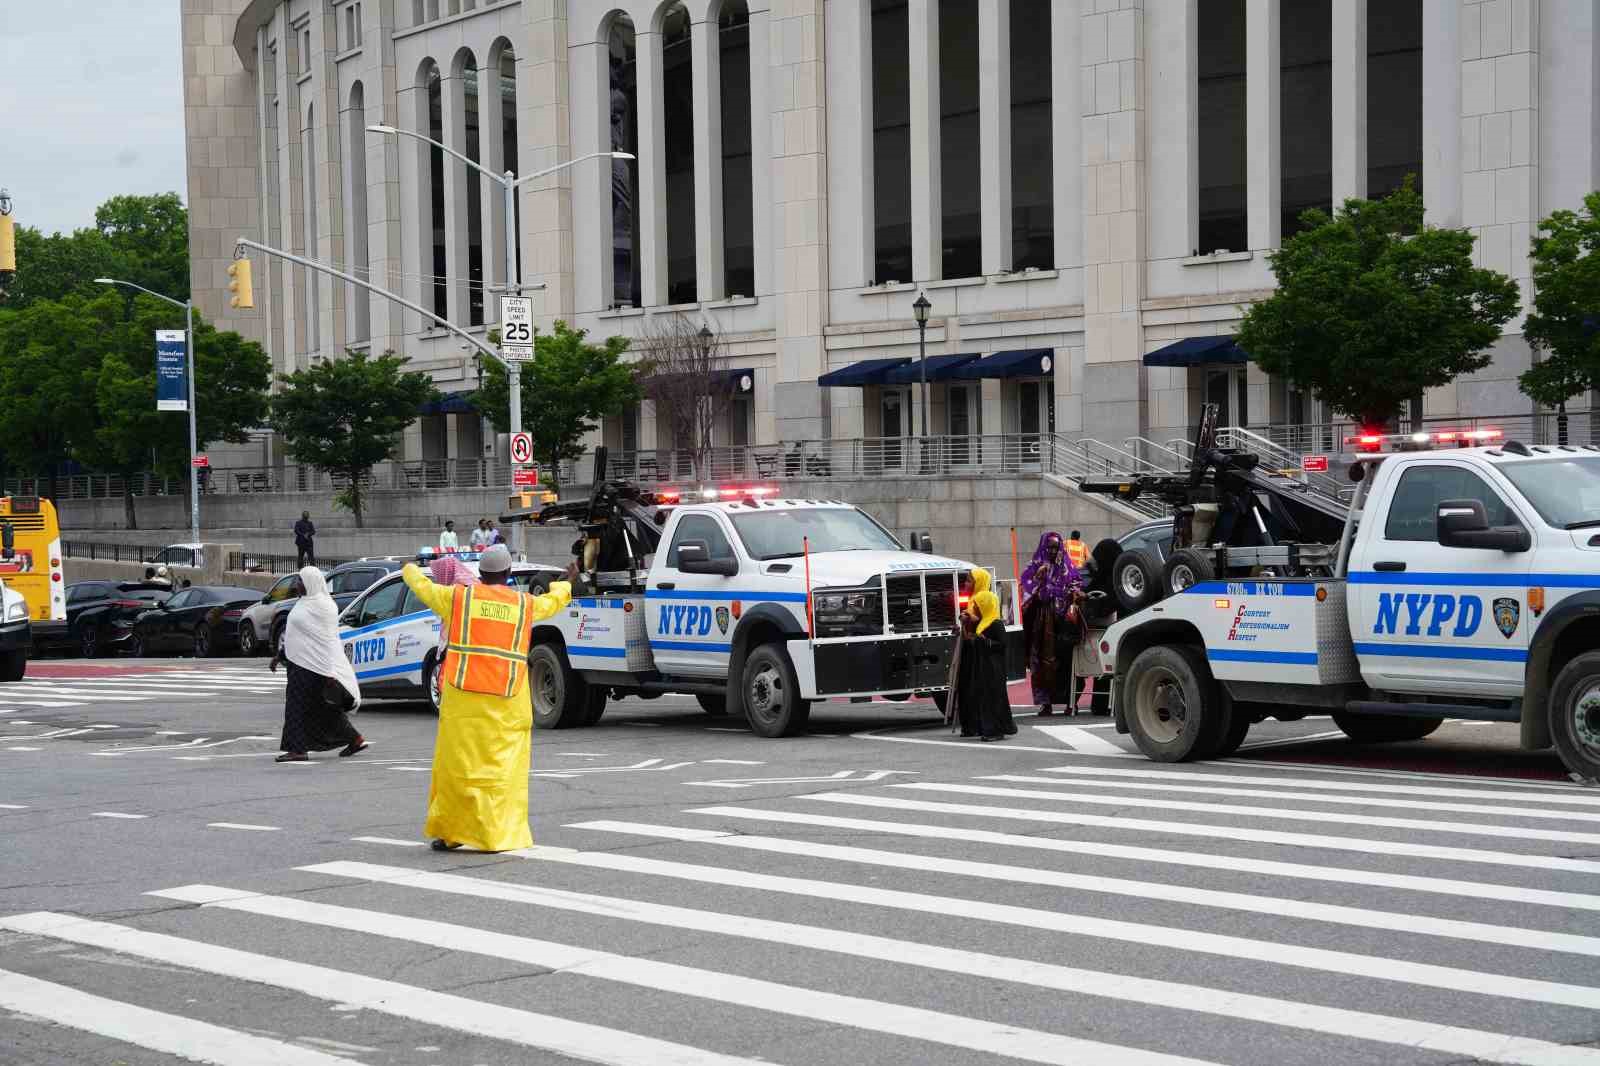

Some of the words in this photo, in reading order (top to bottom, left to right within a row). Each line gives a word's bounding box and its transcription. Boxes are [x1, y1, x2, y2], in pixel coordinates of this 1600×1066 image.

[505, 322, 530, 341] 25
[658, 605, 713, 636] NYPD
[1373, 592, 1483, 637] NYPD
[354, 637, 386, 665] NYPD
